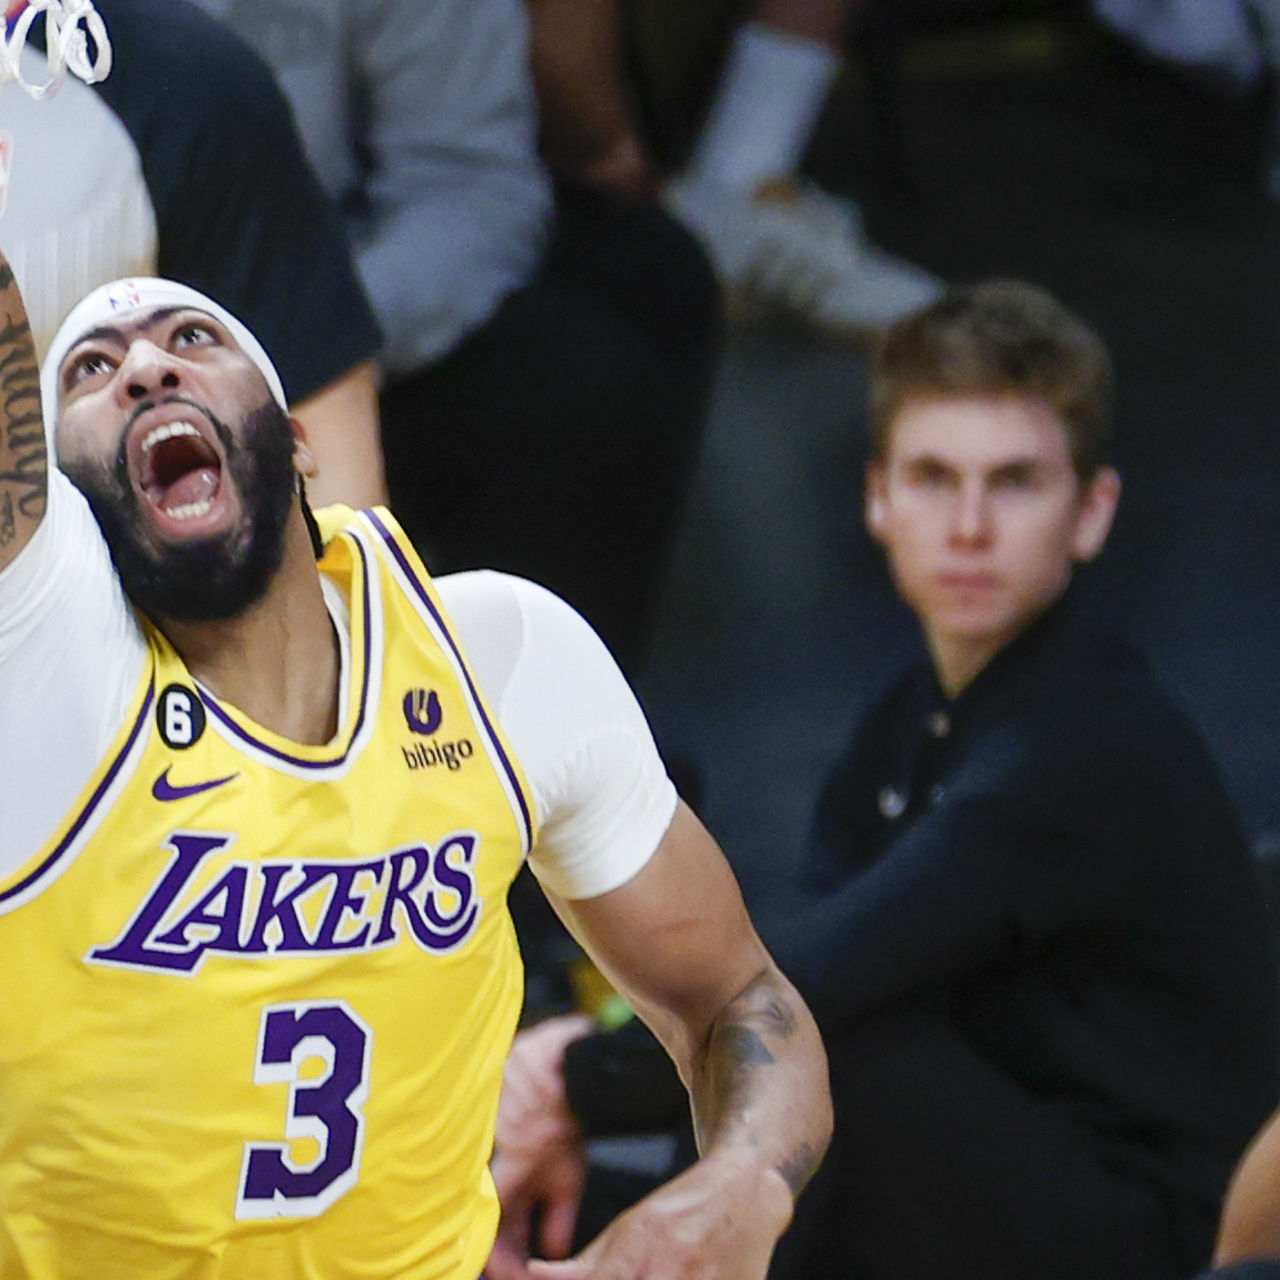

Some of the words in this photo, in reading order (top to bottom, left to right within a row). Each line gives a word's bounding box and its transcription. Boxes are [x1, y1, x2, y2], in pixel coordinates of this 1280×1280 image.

[165, 691, 193, 745] 6
[400, 738, 474, 772] bibigo
[85, 831, 484, 977] LAKERS
[235, 998, 375, 1219] 3
